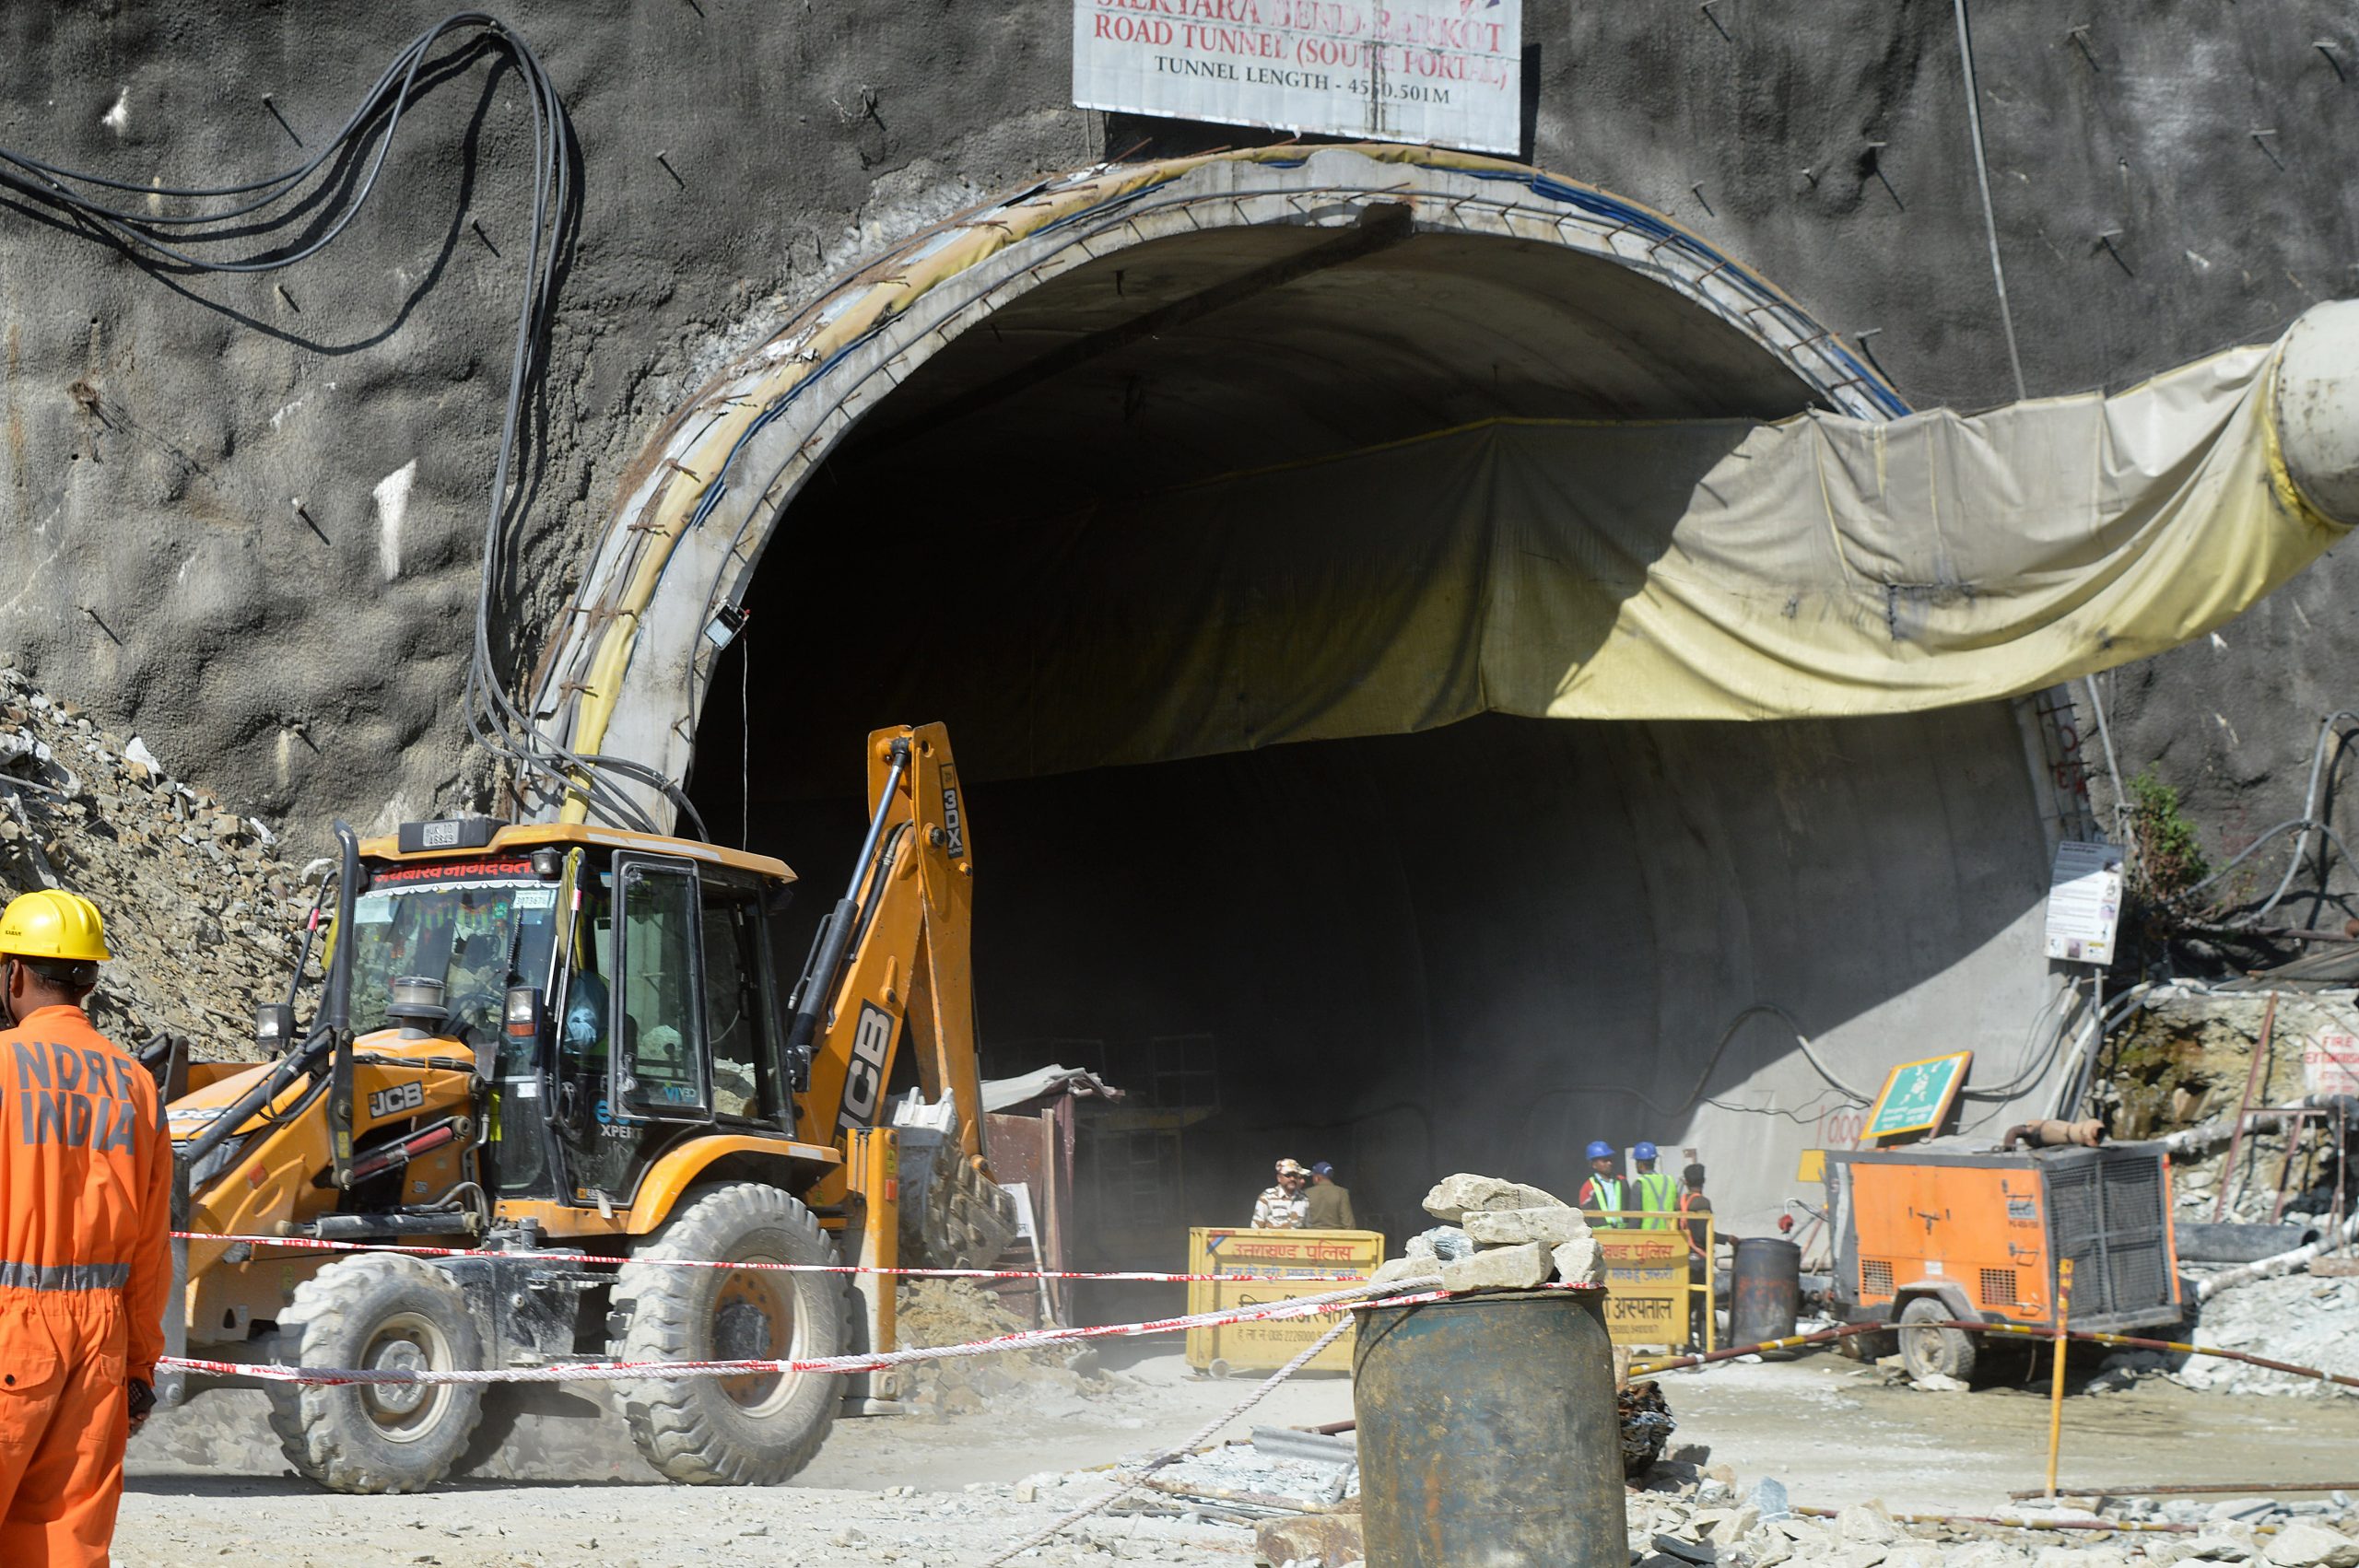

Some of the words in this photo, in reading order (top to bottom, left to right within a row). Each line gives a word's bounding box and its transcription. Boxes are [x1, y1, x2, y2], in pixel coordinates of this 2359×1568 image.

[1097, 0, 1260, 24] KYARA
[1095, 14, 1173, 45] ROAD
[1181, 24, 1287, 59] TUNNEL
[1155, 55, 1239, 81] TUNNEL
[1247, 66, 1329, 90] LENGTH
[945, 790, 962, 848] 3DX
[12, 1042, 133, 1100] NDRF
[370, 1083, 423, 1117] JCB
[21, 1091, 135, 1155] INDIA
